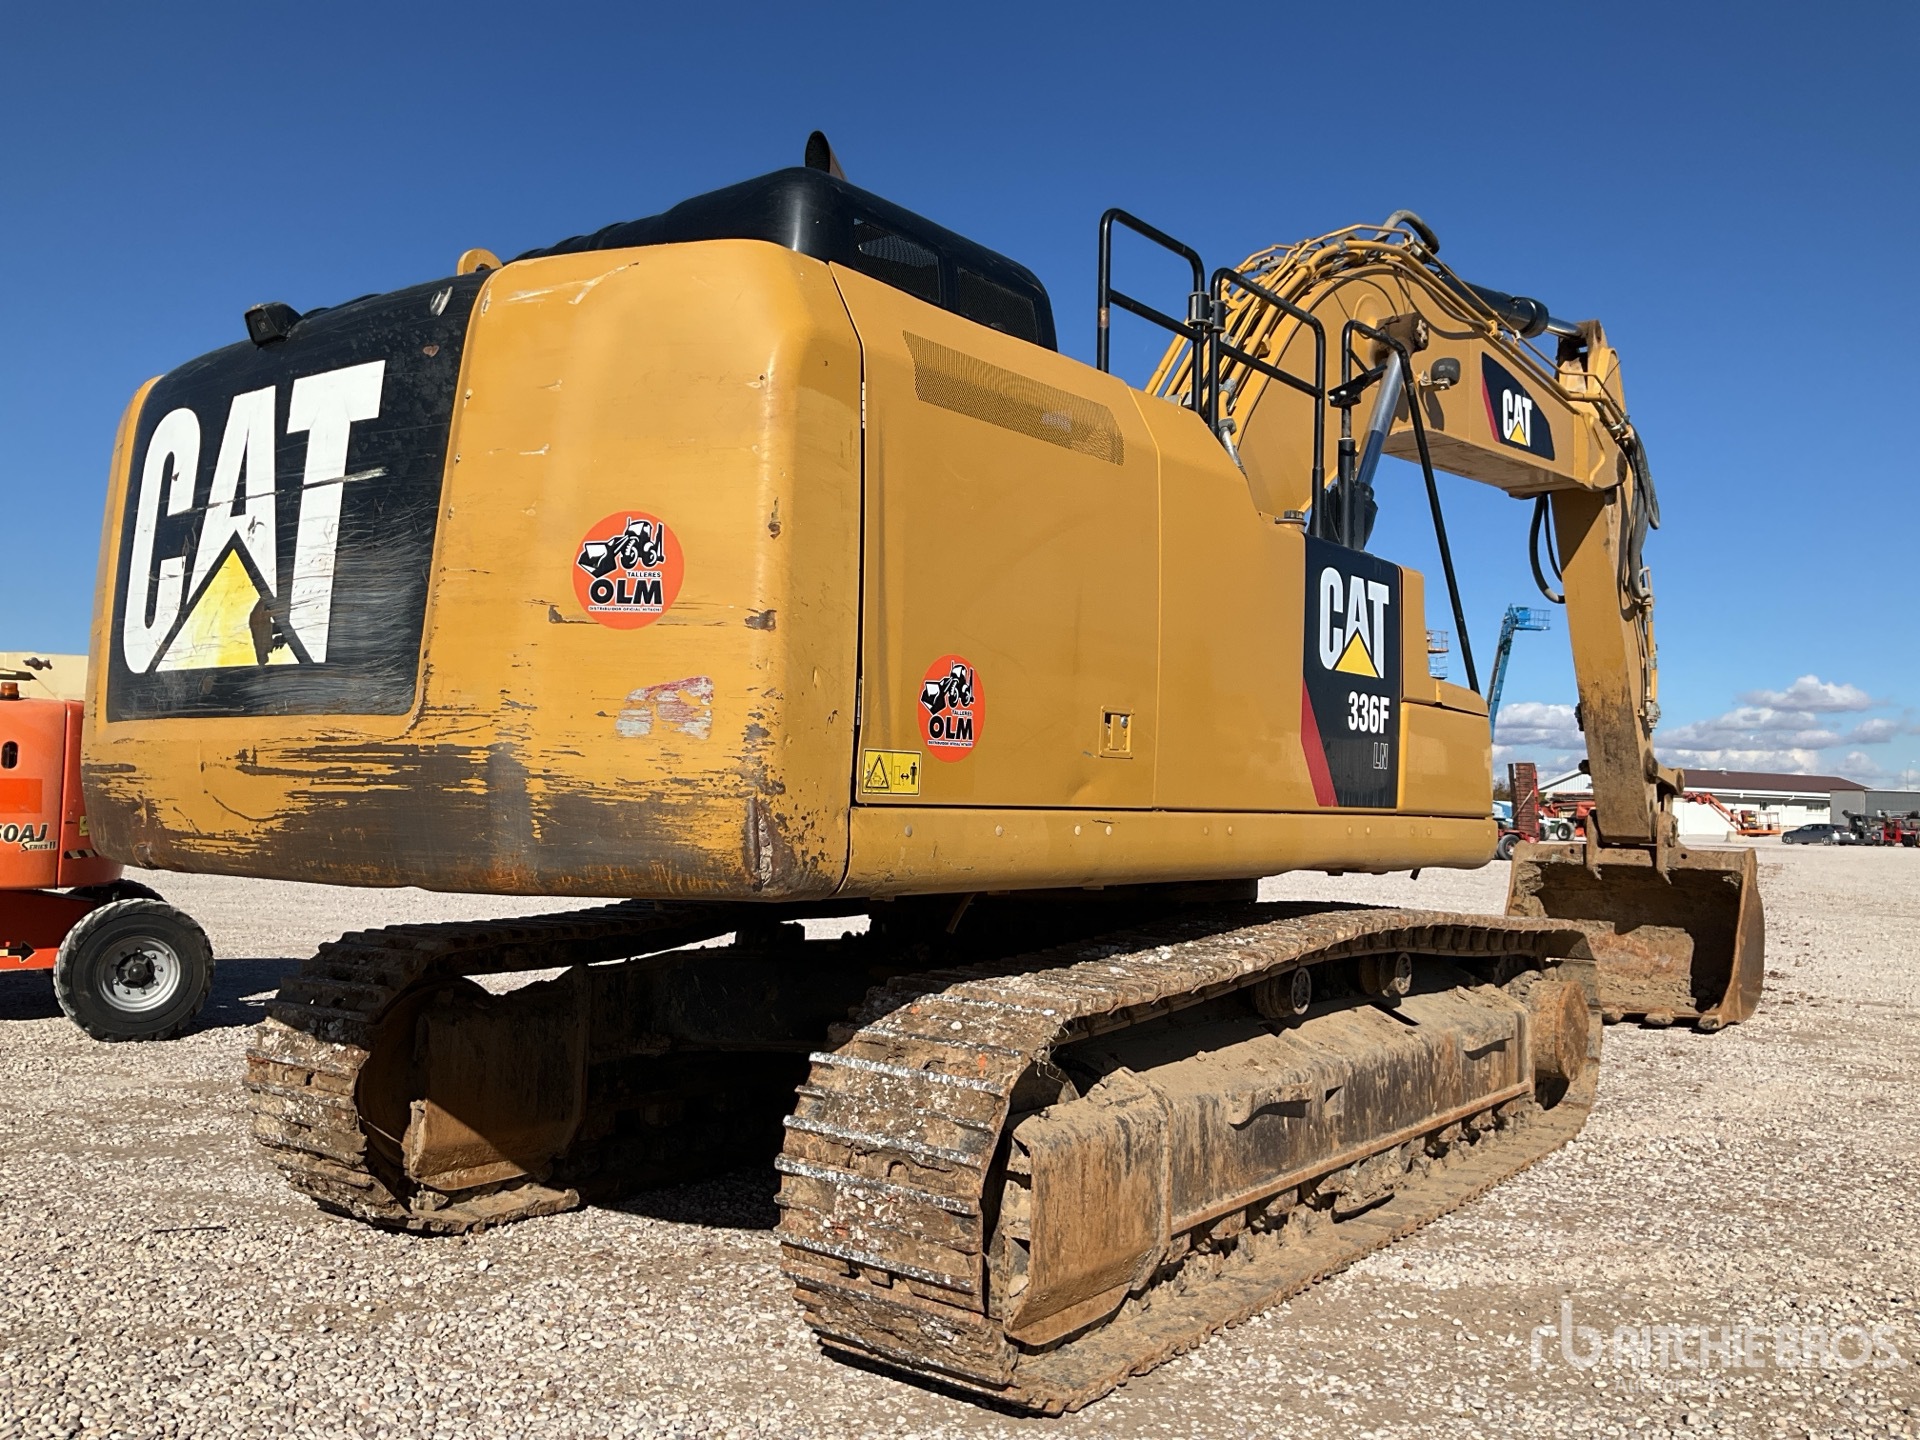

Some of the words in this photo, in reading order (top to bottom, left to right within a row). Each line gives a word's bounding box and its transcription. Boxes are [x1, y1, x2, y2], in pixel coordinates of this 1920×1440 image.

[1502, 388, 1533, 447] CAT
[124, 360, 386, 674] CAT
[590, 578, 663, 604] OLM
[1319, 566, 1390, 679] CAT
[929, 715, 973, 740] OLM
[1347, 690, 1390, 734] 336F
[1372, 741, 1389, 770] LN
[0, 824, 48, 843] 0AJ
